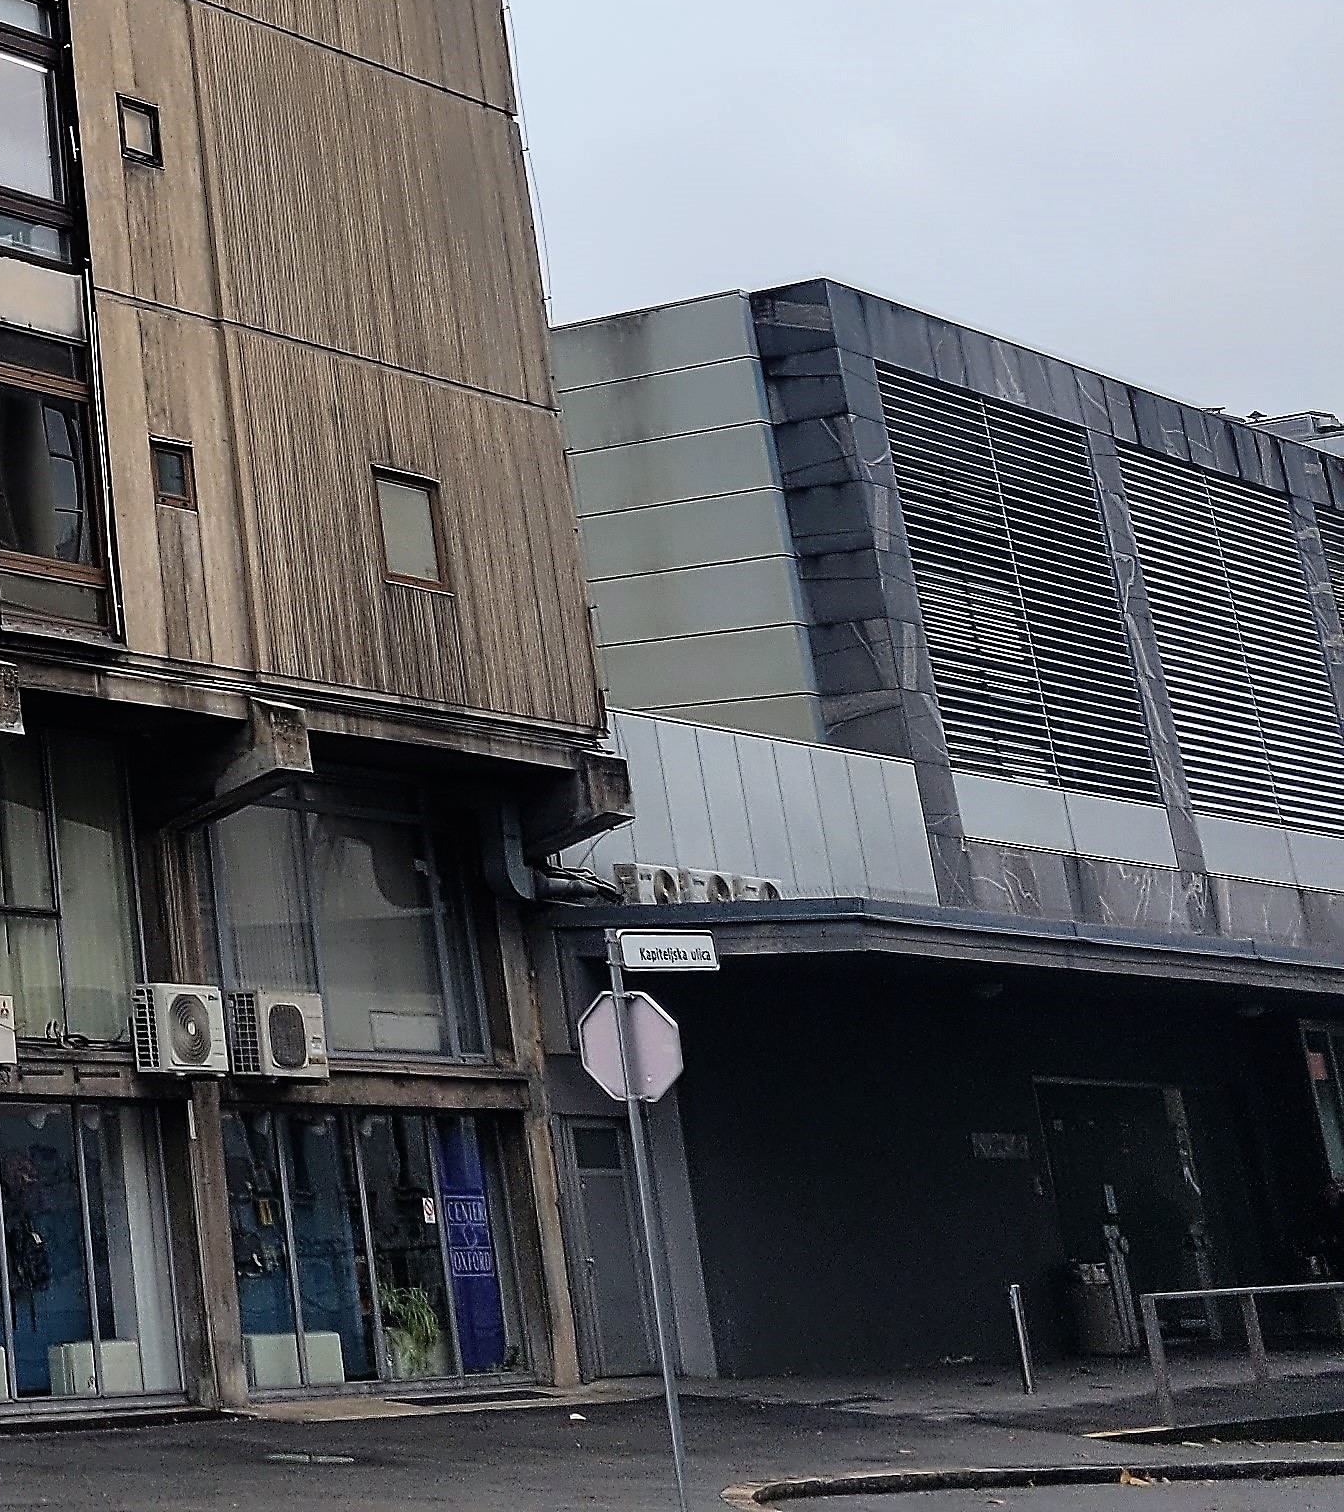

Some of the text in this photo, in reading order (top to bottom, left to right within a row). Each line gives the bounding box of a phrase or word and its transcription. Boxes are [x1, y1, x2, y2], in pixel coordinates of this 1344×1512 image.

[639, 947, 712, 964] Kapiteljska ulica
[454, 1251, 492, 1271] OXFORD
